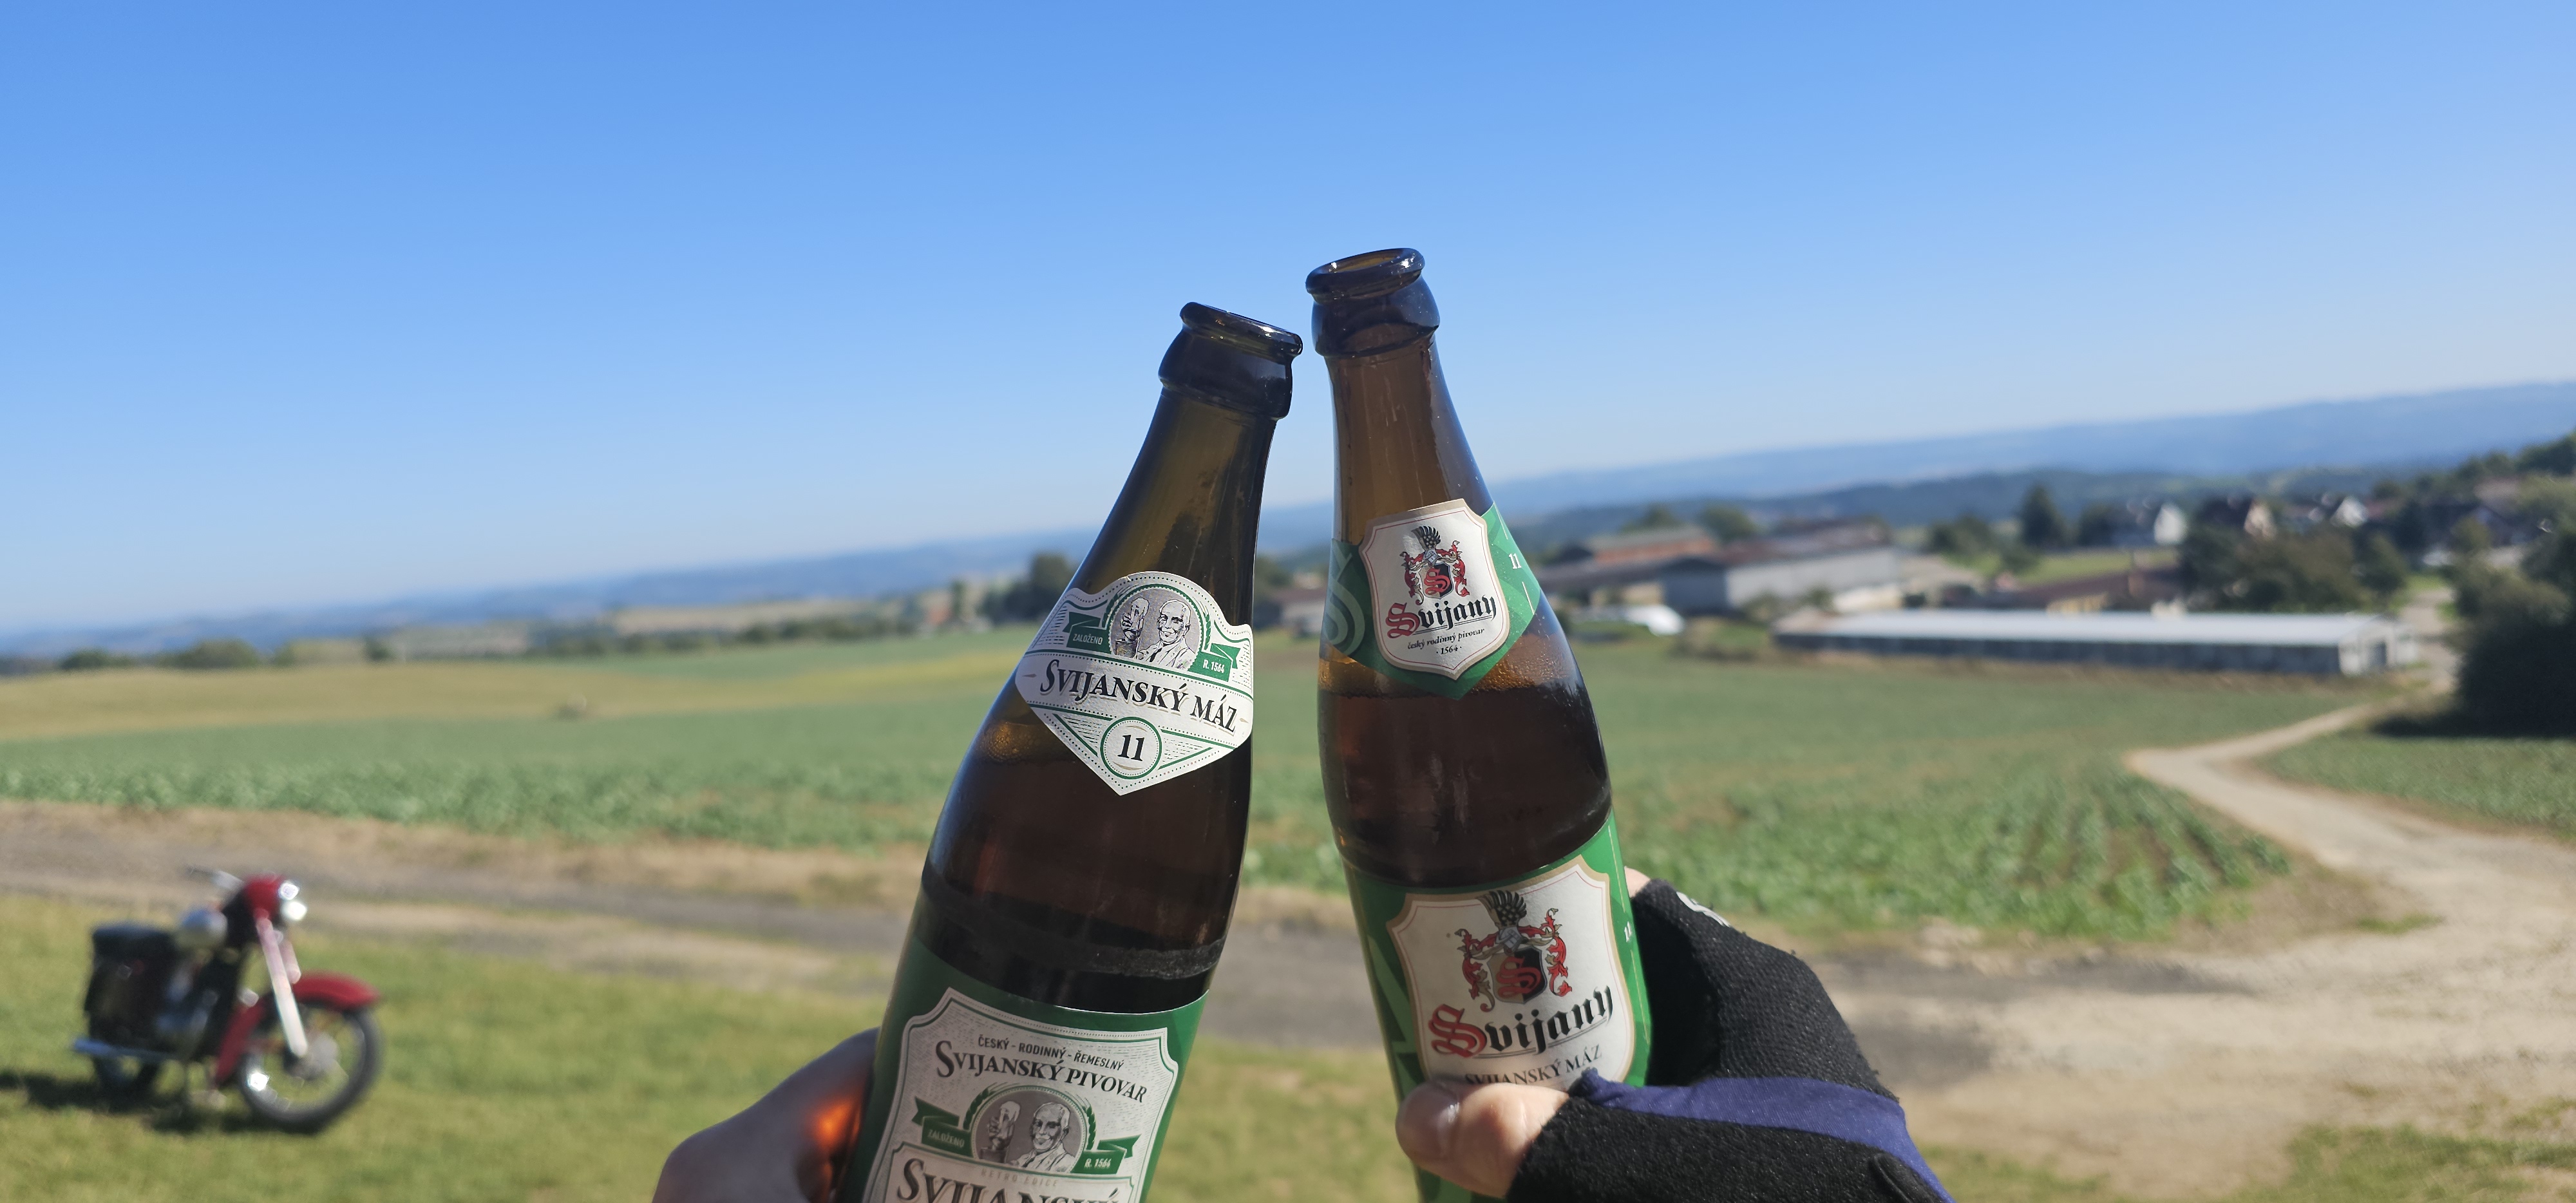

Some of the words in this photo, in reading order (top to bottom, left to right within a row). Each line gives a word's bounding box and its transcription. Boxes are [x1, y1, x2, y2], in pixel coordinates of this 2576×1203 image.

[1508, 553, 1522, 569] 11
[1385, 594, 1497, 639] Svijany
[1072, 633, 1103, 645] ZALOŽENO
[1407, 639, 1425, 650] český
[1426, 632, 1456, 646] rodinný
[1440, 644, 1459, 655] 1564
[1202, 659, 1209, 670] R.
[1211, 661, 1226, 674] 1564
[1040, 659, 1189, 712] SVIJANSKÝ
[1189, 694, 1237, 733] MÁZ
[1117, 734, 1145, 762] 11
[1428, 985, 1613, 1058] Svijany
[978, 1036, 1009, 1050] ČESKÝ
[1018, 1042, 1066, 1059] RODINNÝ
[1073, 1050, 1124, 1071] ŘEMESLNÝ
[1565, 1043, 1602, 1074] MÁZ
[935, 1039, 1065, 1081] SVIJANSKÝ
[1065, 1067, 1148, 1103] PIVOVAR
